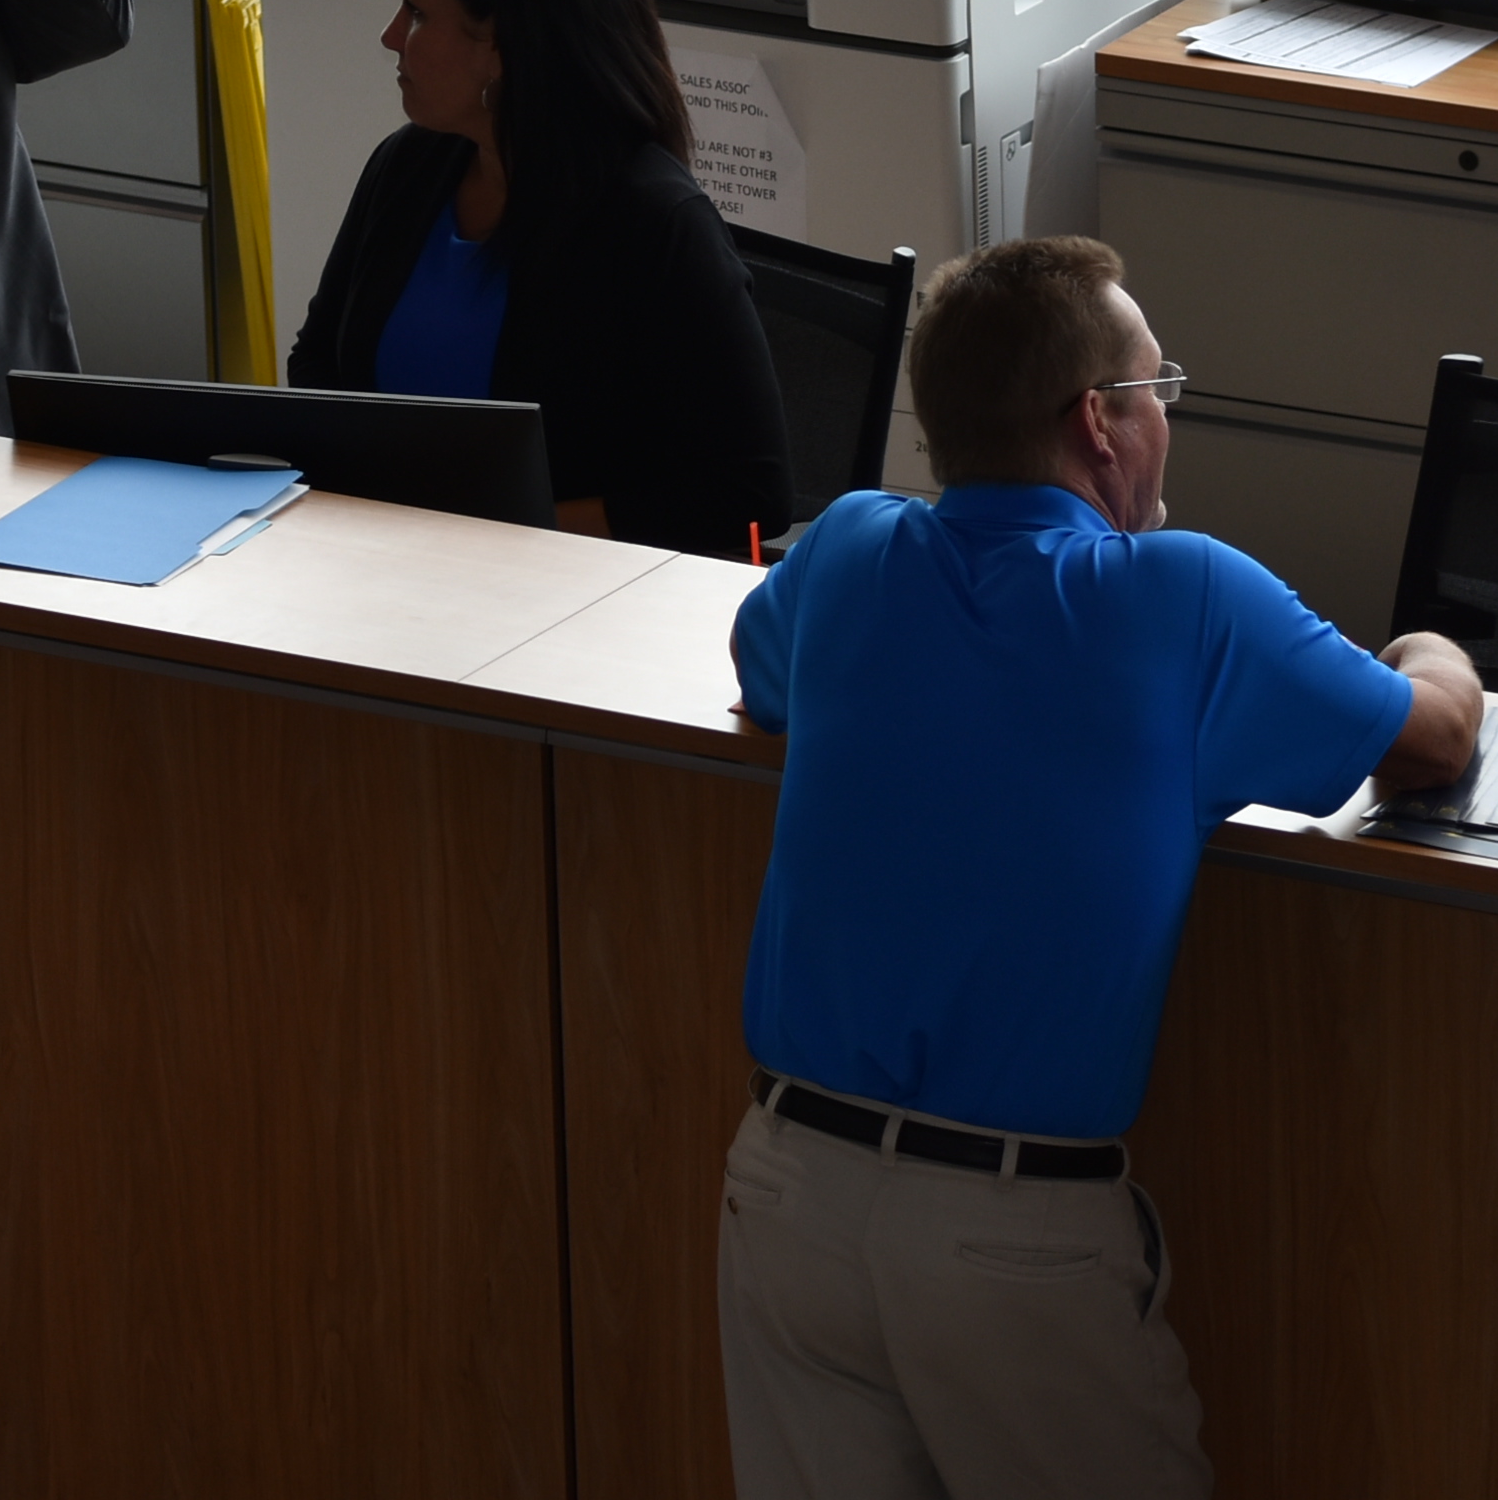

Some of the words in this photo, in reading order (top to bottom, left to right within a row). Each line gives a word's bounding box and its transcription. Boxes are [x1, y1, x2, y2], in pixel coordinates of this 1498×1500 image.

[680, 73, 712, 89] SALES
[714, 98, 738, 113] THIS
[708, 142, 730, 155] ARE
[732, 146, 757, 159] NOT
[759, 150, 773, 162] #3
[695, 158, 713, 171] ON
[715, 161, 737, 175] THE
[739, 165, 777, 182] OTHER
[711, 179, 734, 193] THE
[735, 183, 777, 201] TOWER
[714, 199, 744, 214] EASE!
